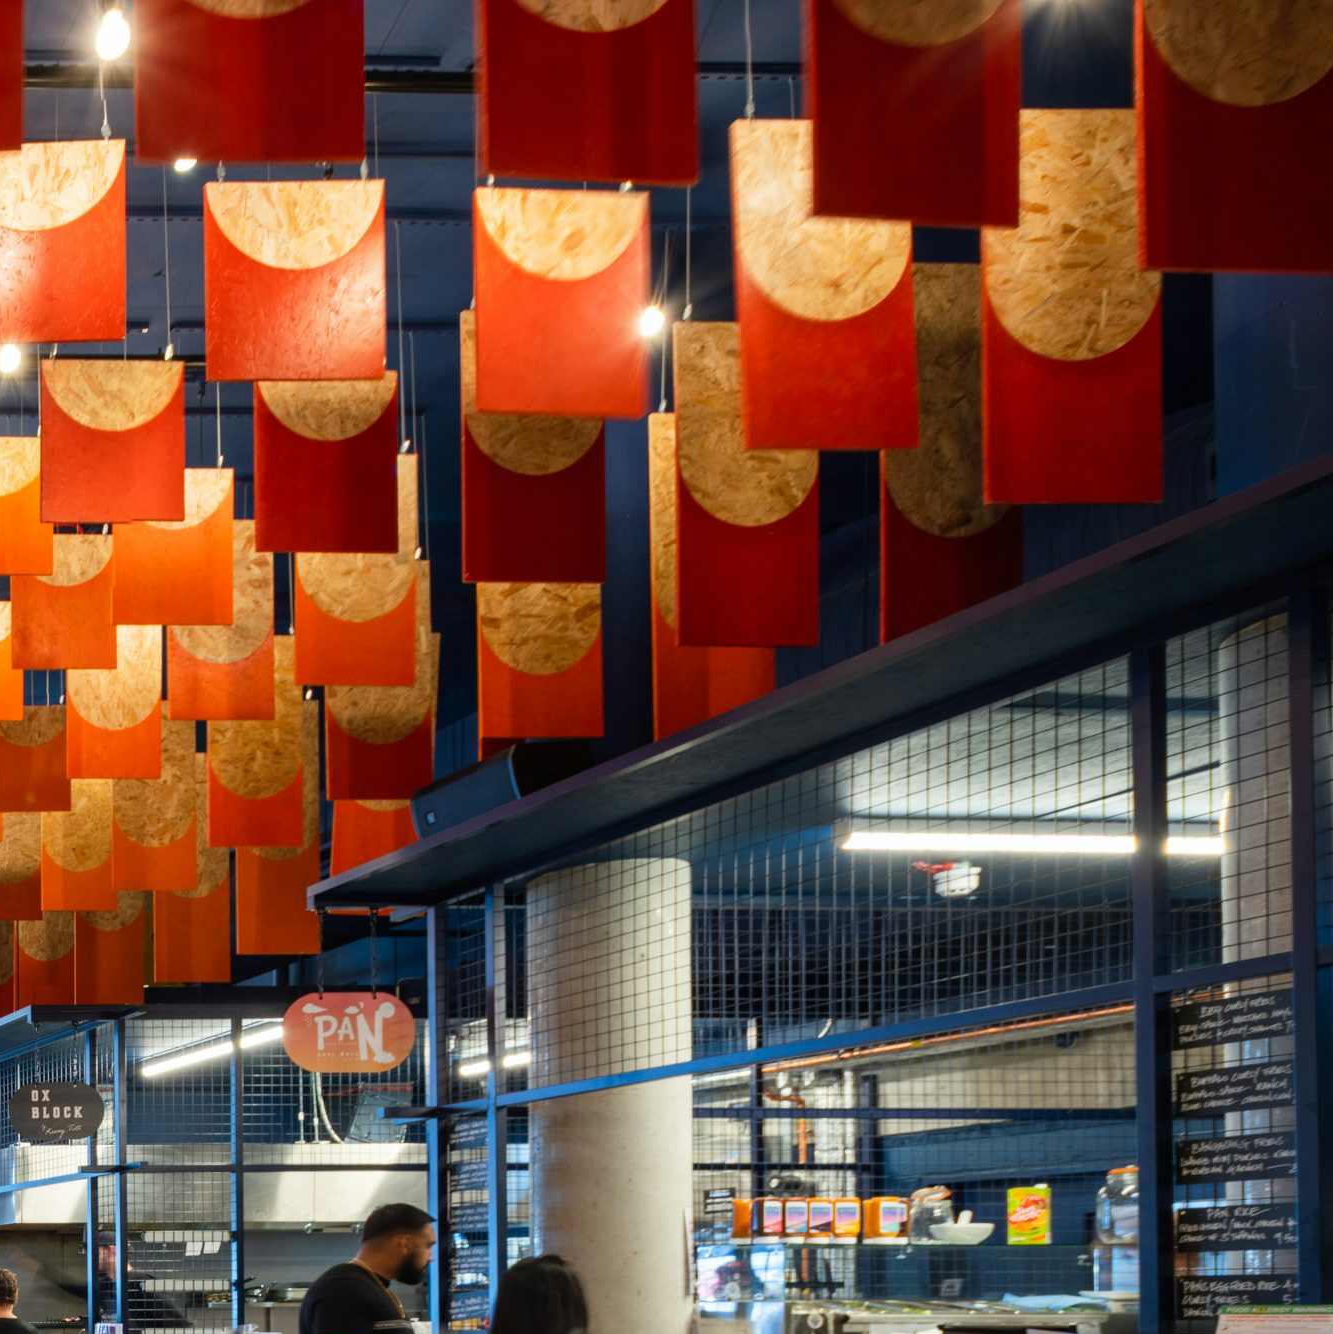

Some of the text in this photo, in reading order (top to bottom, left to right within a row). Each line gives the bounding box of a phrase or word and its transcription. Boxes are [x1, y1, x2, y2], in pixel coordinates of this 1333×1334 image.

[315, 1008, 393, 1063] PAN
[31, 1090, 50, 1101] OX
[31, 1106, 83, 1119] BLOCK
